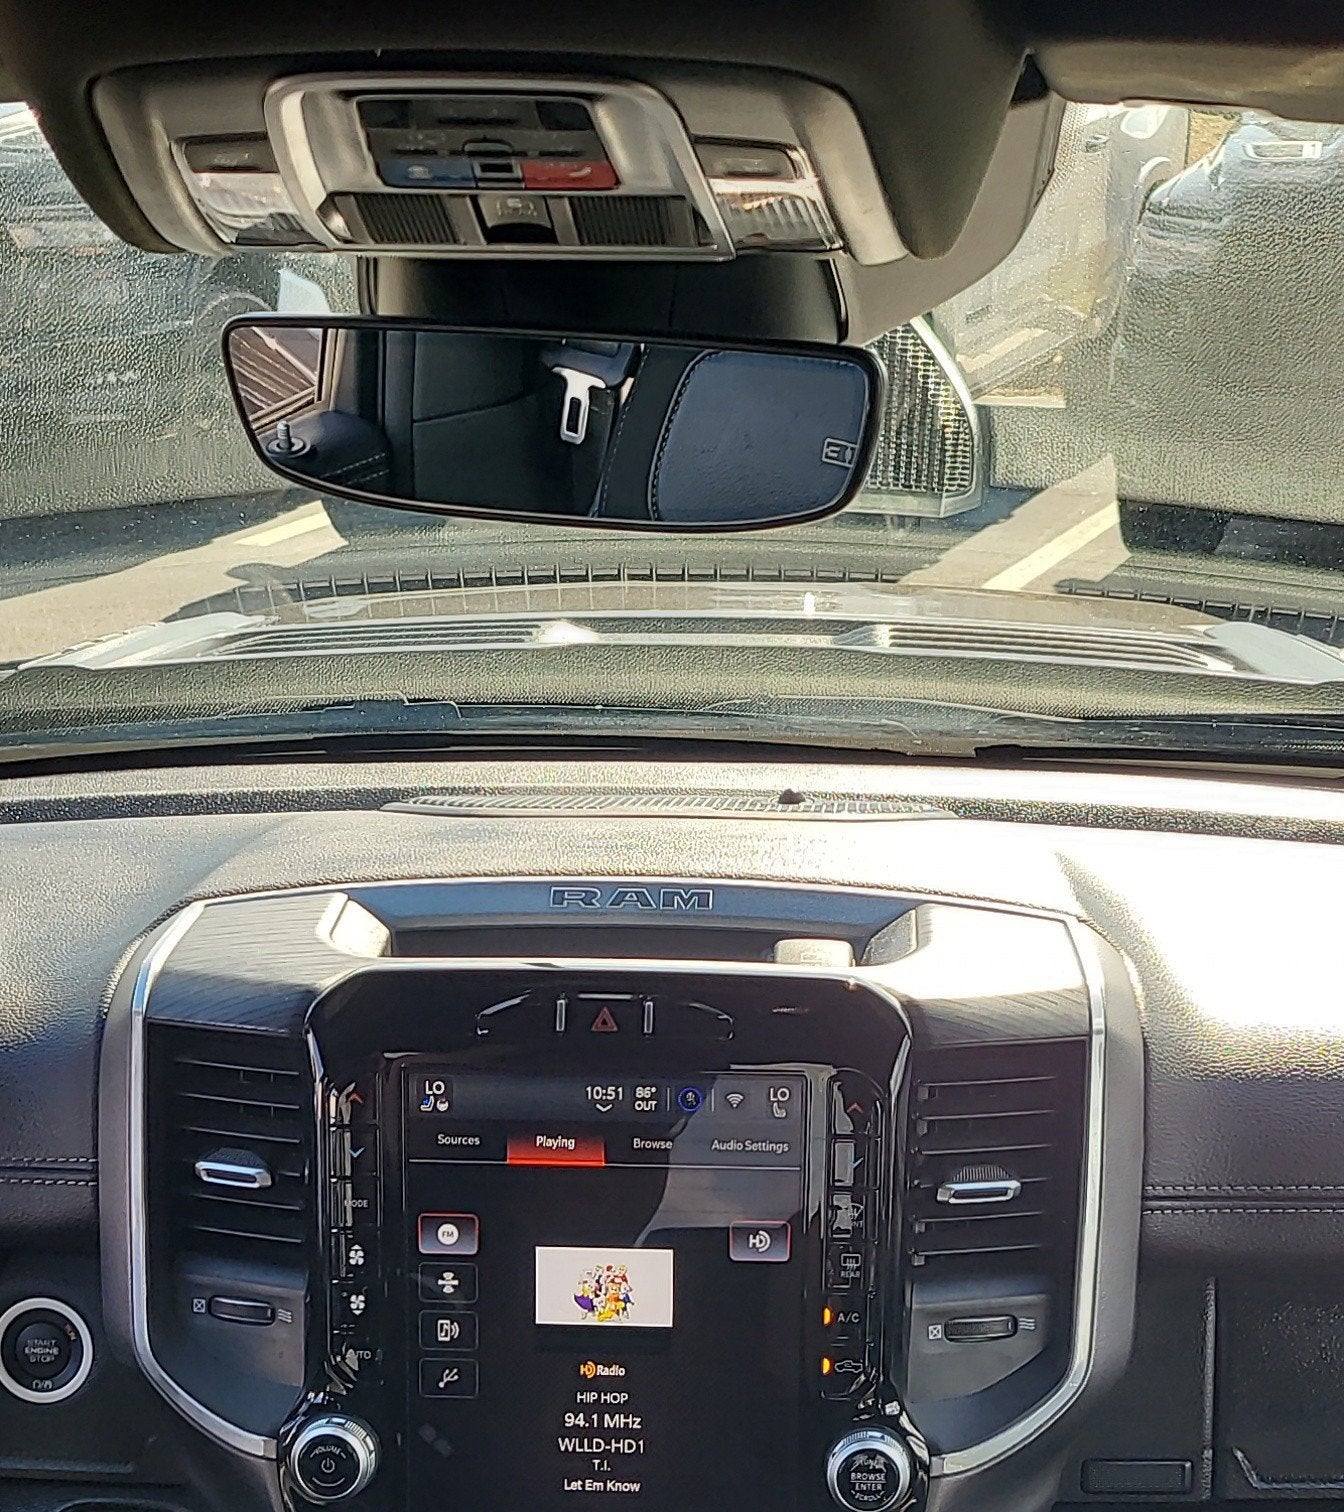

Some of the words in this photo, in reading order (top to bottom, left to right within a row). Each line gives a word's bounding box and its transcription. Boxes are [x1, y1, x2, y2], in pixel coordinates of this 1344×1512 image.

[549, 886, 713, 910] RAM
[425, 1080, 445, 1095] LO
[585, 1085, 623, 1101] 10:51
[769, 1087, 790, 1101] LO
[634, 1100, 657, 1111] OUT
[437, 1133, 480, 1145] Sources
[535, 1135, 576, 1150] Playing
[633, 1138, 673, 1149] Browse
[711, 1139, 744, 1151] Audio
[744, 1140, 789, 1154] Settings
[344, 1199, 368, 1208] MODE
[441, 1230, 455, 1238] FM
[837, 1312, 860, 1323] A/C
[24, 1346, 59, 1355] ENGINE
[596, 1364, 626, 1376] Radio
[576, 1391, 598, 1403] HIP
[600, 1392, 629, 1404] HOP
[564, 1412, 598, 1428] 94.1
[603, 1413, 642, 1429] MHz
[558, 1437, 644, 1454] WLLD-HD1
[592, 1459, 611, 1471] T.I.
[850, 1472, 886, 1481] BROWSE
[564, 1478, 583, 1491] Let
[584, 1479, 604, 1491] Em
[606, 1480, 641, 1493] Know
[855, 1482, 882, 1491] ENTER
